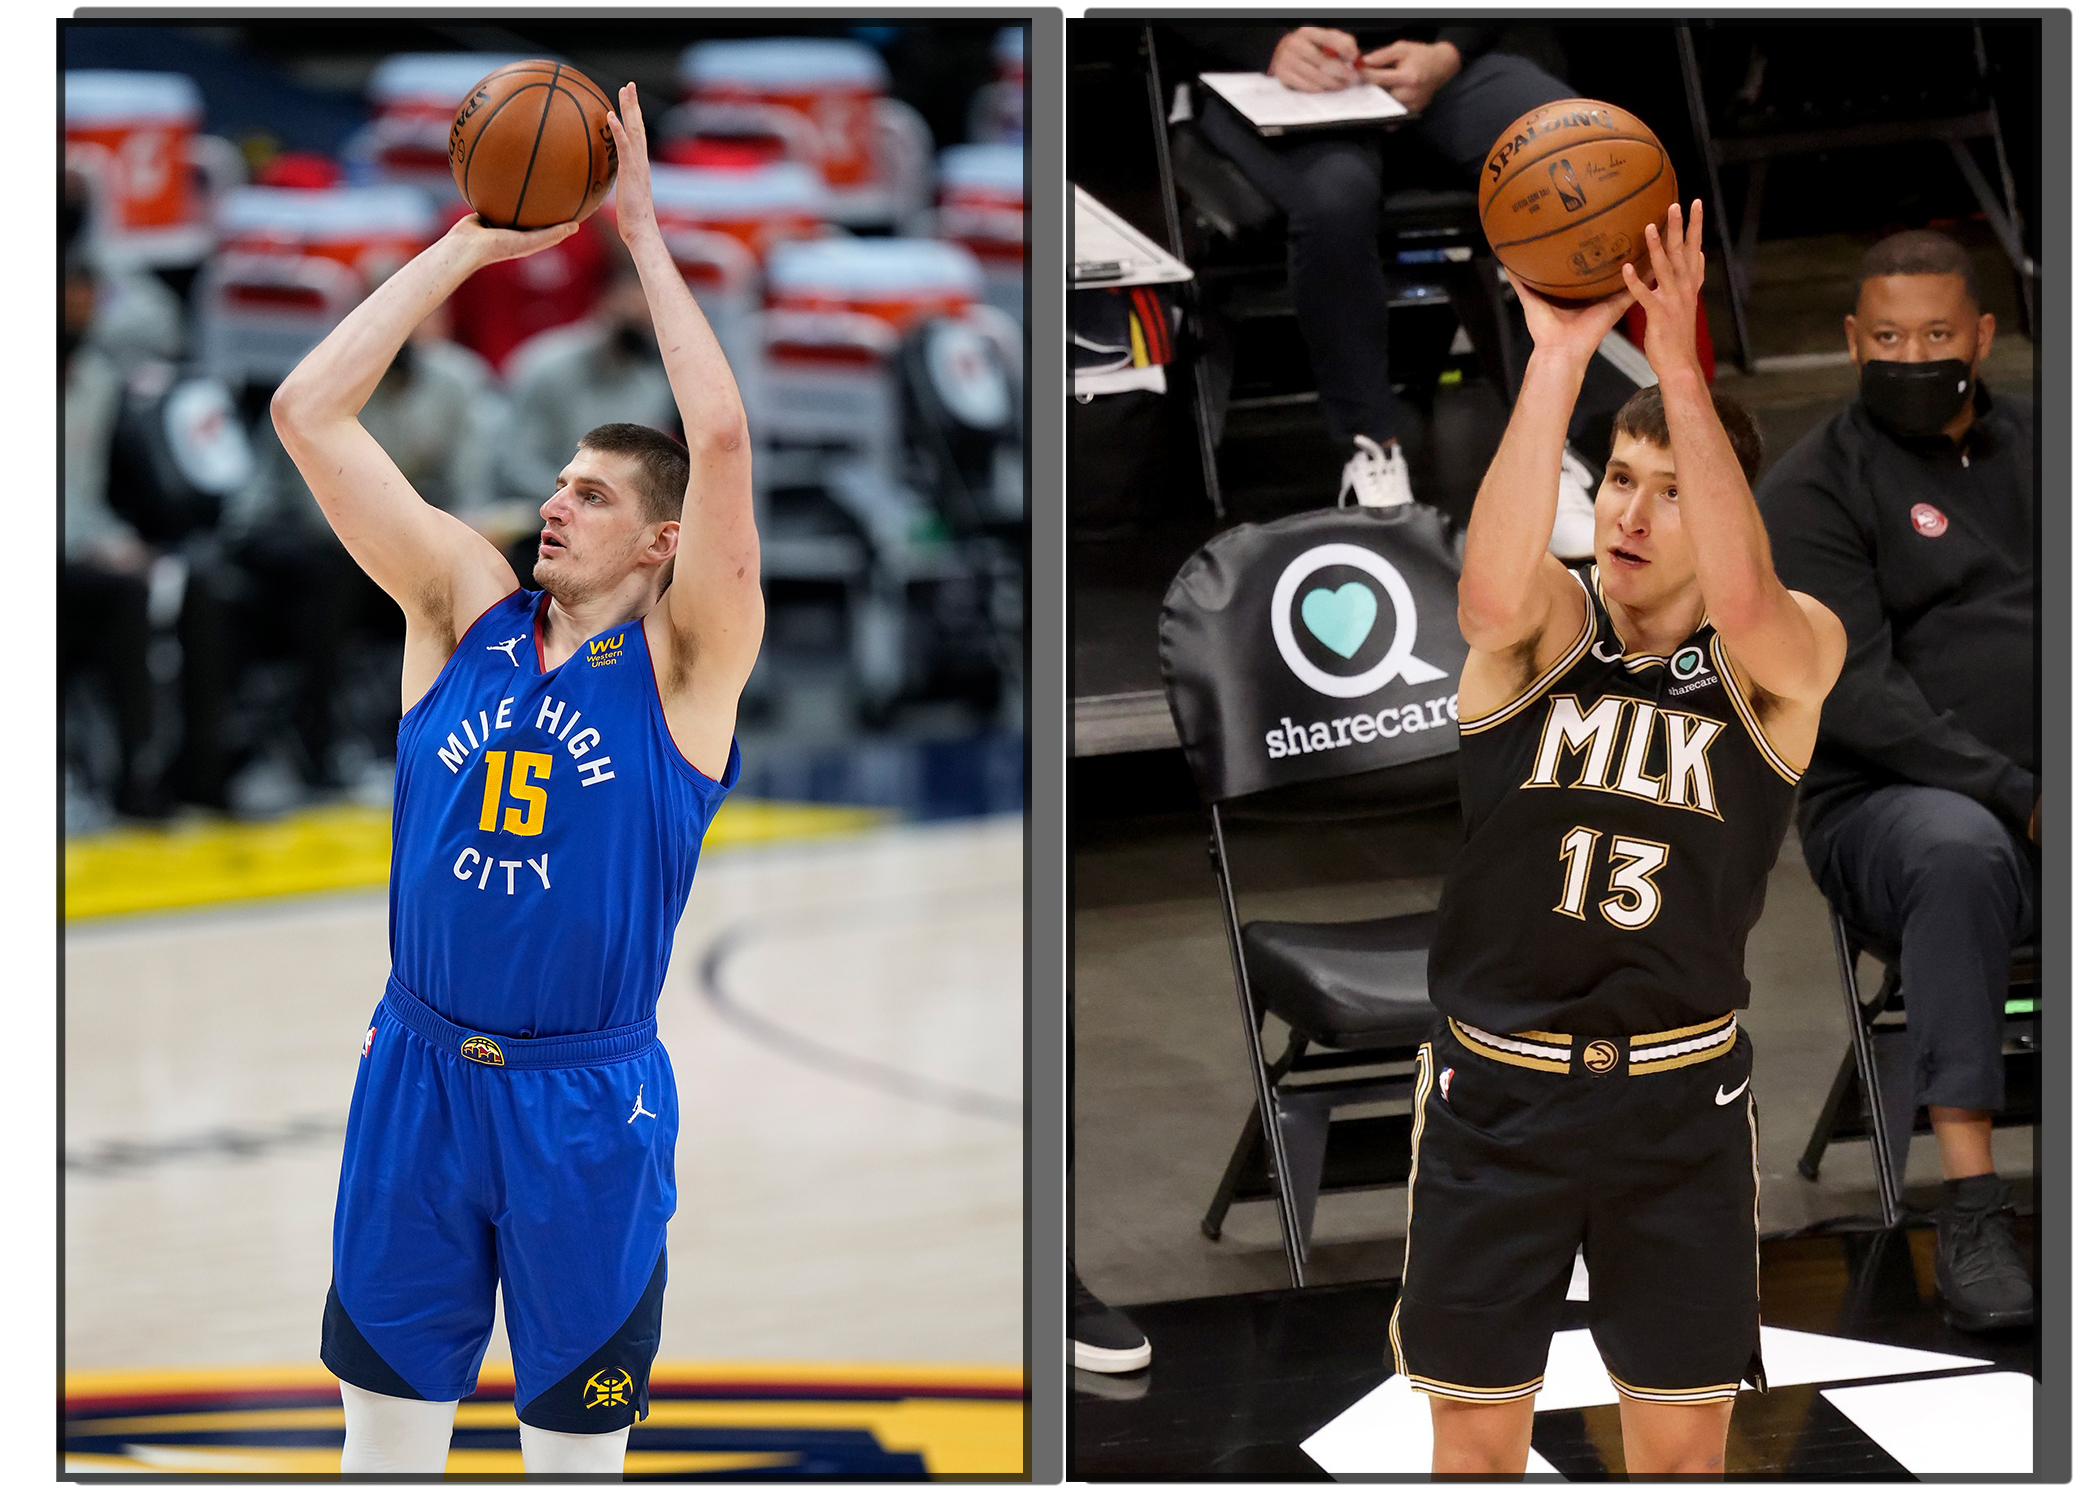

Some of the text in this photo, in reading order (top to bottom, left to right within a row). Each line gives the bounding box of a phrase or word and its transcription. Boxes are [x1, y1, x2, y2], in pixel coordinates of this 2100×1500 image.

[1488, 109, 1613, 183] SPALDING
[586, 650, 623, 663] Western
[589, 633, 624, 655] WU
[591, 658, 617, 668] Union
[535, 695, 616, 788] HIGH
[1519, 693, 1728, 823] MLK
[479, 750, 553, 836] 15
[453, 847, 551, 895] CITY
[1552, 825, 1670, 931] 13
